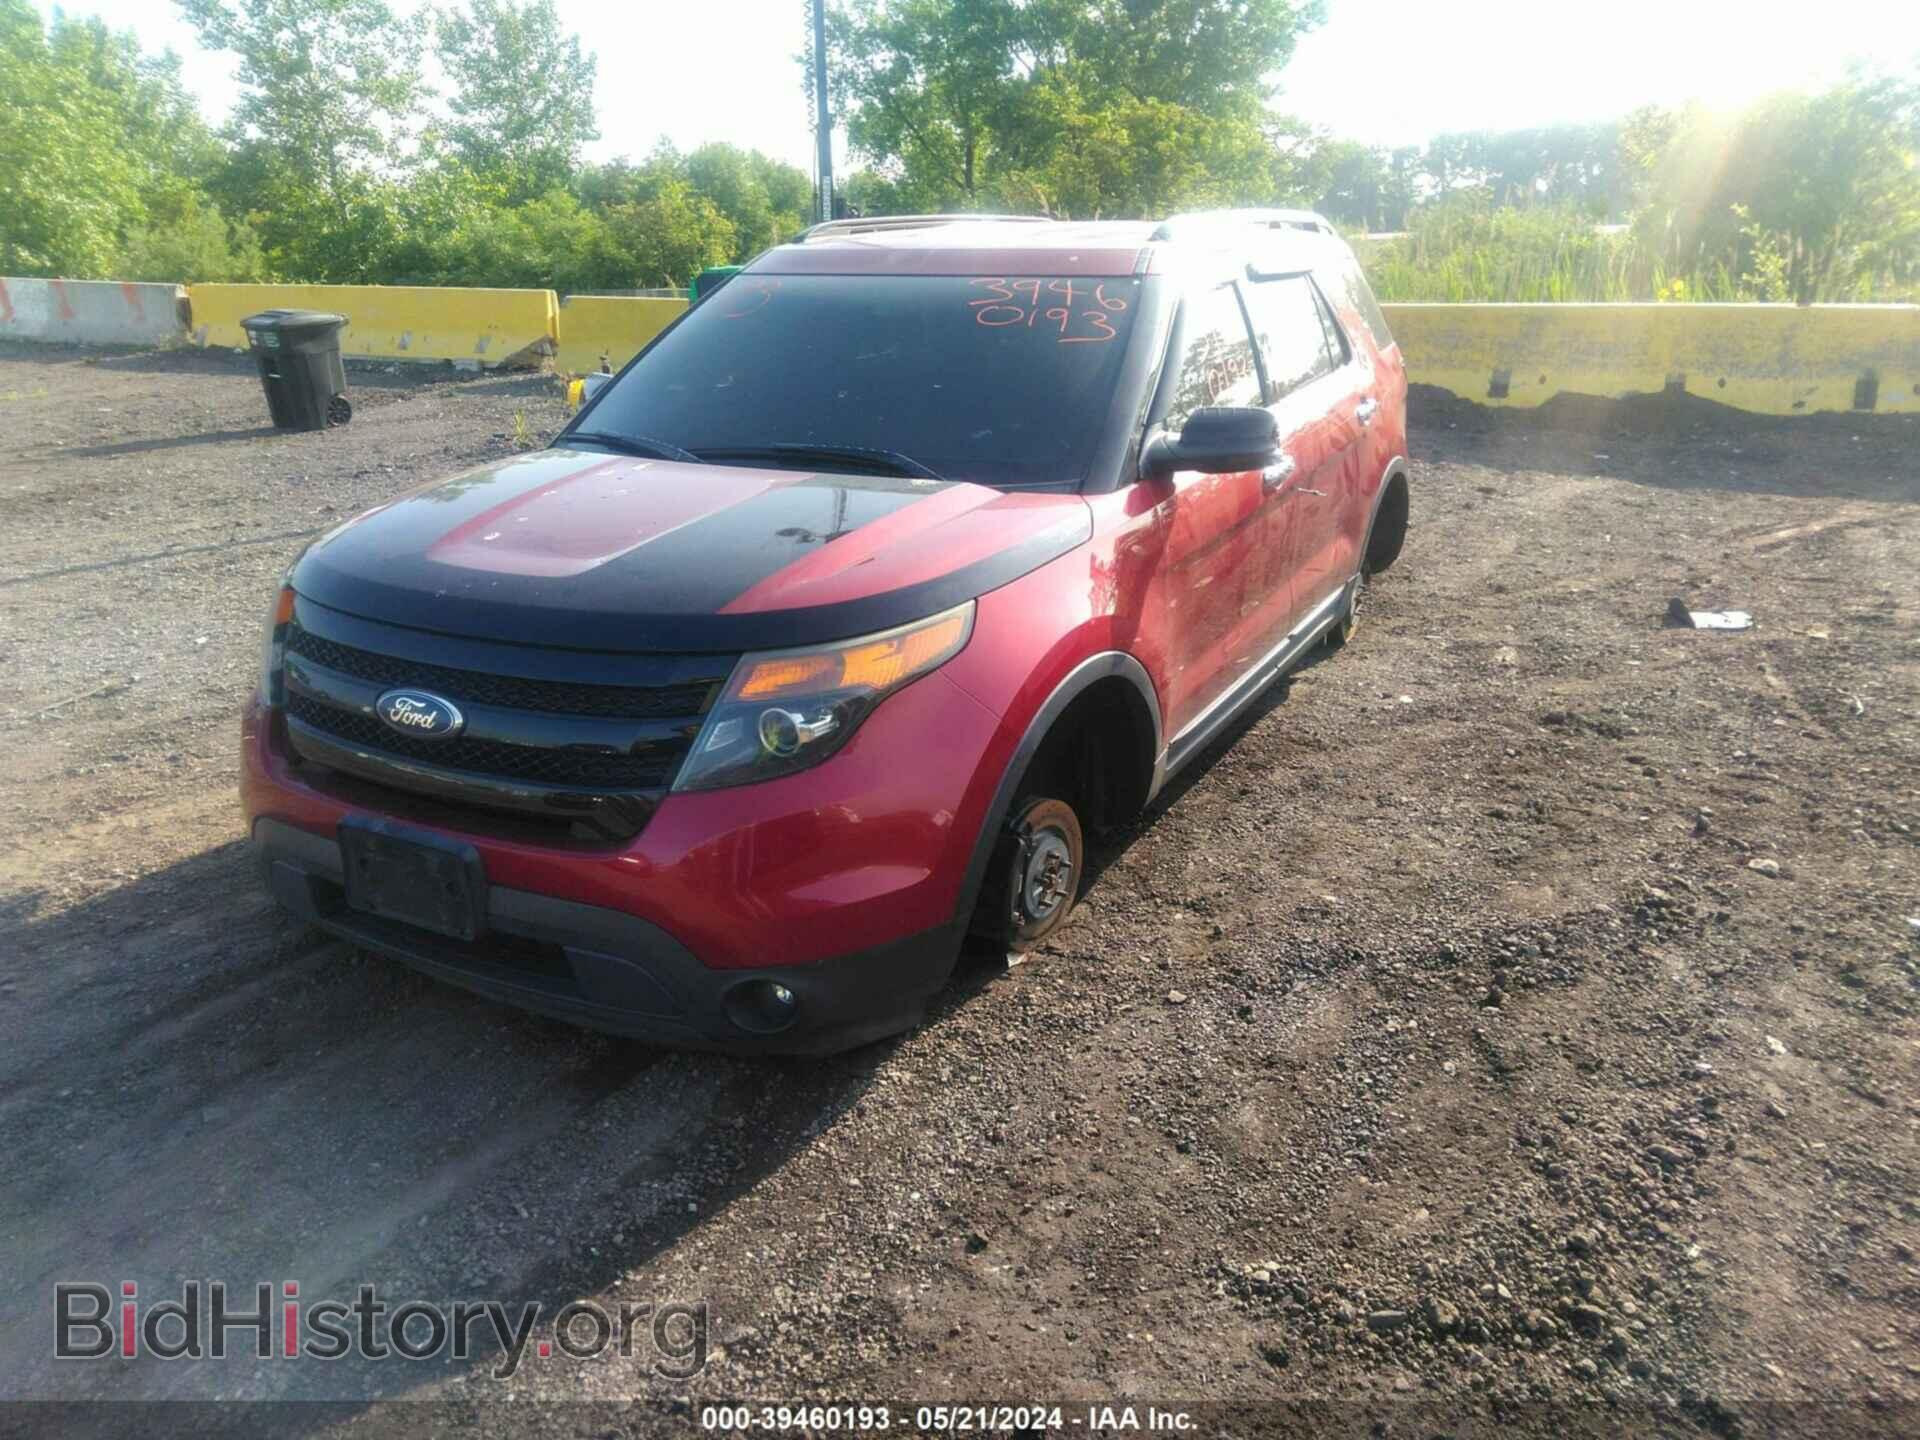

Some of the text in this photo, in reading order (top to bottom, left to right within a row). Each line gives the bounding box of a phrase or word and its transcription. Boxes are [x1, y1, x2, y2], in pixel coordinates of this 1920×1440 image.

[969, 278, 1127, 310] 3946
[976, 305, 1116, 342] 0193
[389, 697, 438, 729] Ford
